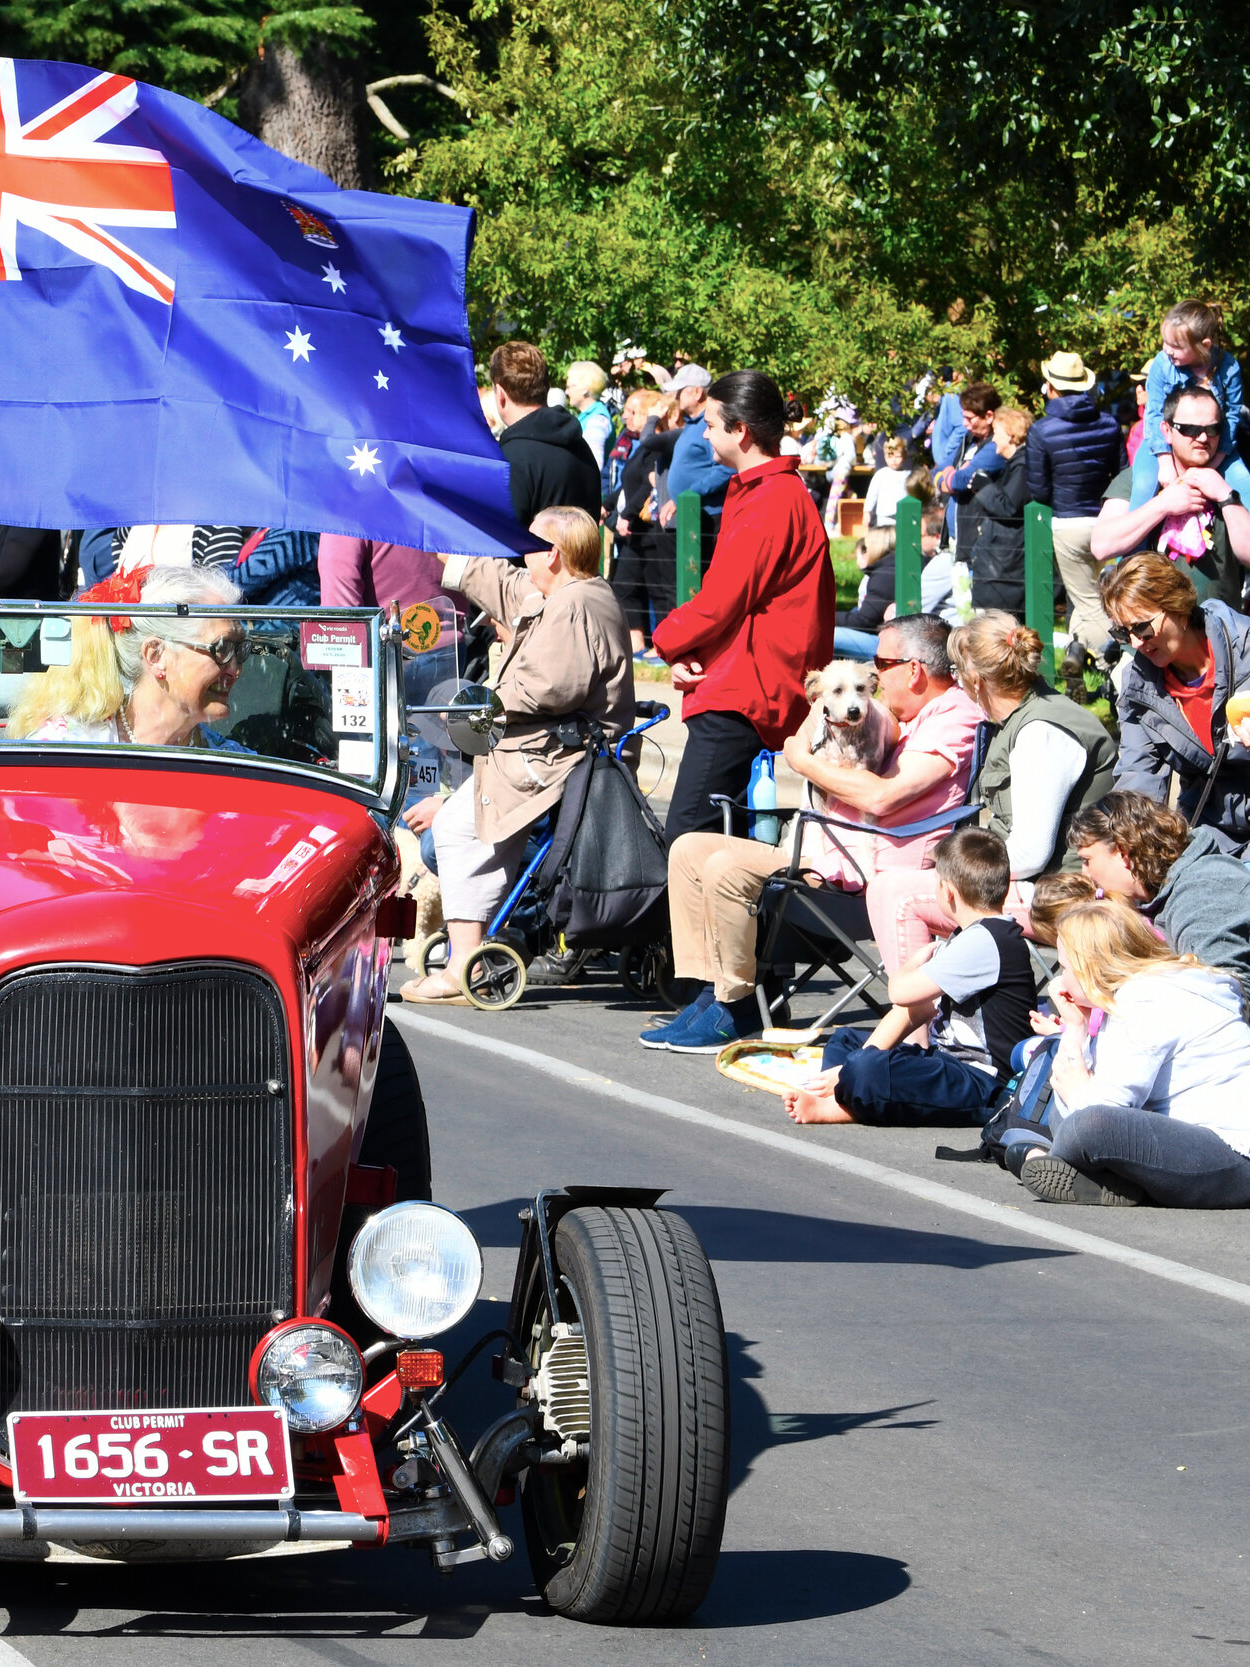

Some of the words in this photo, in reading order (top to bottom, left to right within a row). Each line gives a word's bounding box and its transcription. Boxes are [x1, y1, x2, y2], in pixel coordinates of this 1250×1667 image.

[311, 634, 329, 643] Club
[330, 634, 357, 644] Permit
[342, 714, 367, 727] 132
[419, 765, 437, 784] 457
[110, 1415, 141, 1430] CLUB
[143, 1414, 185, 1429] PERMIT
[113, 1481, 196, 1497] VICTORIA
